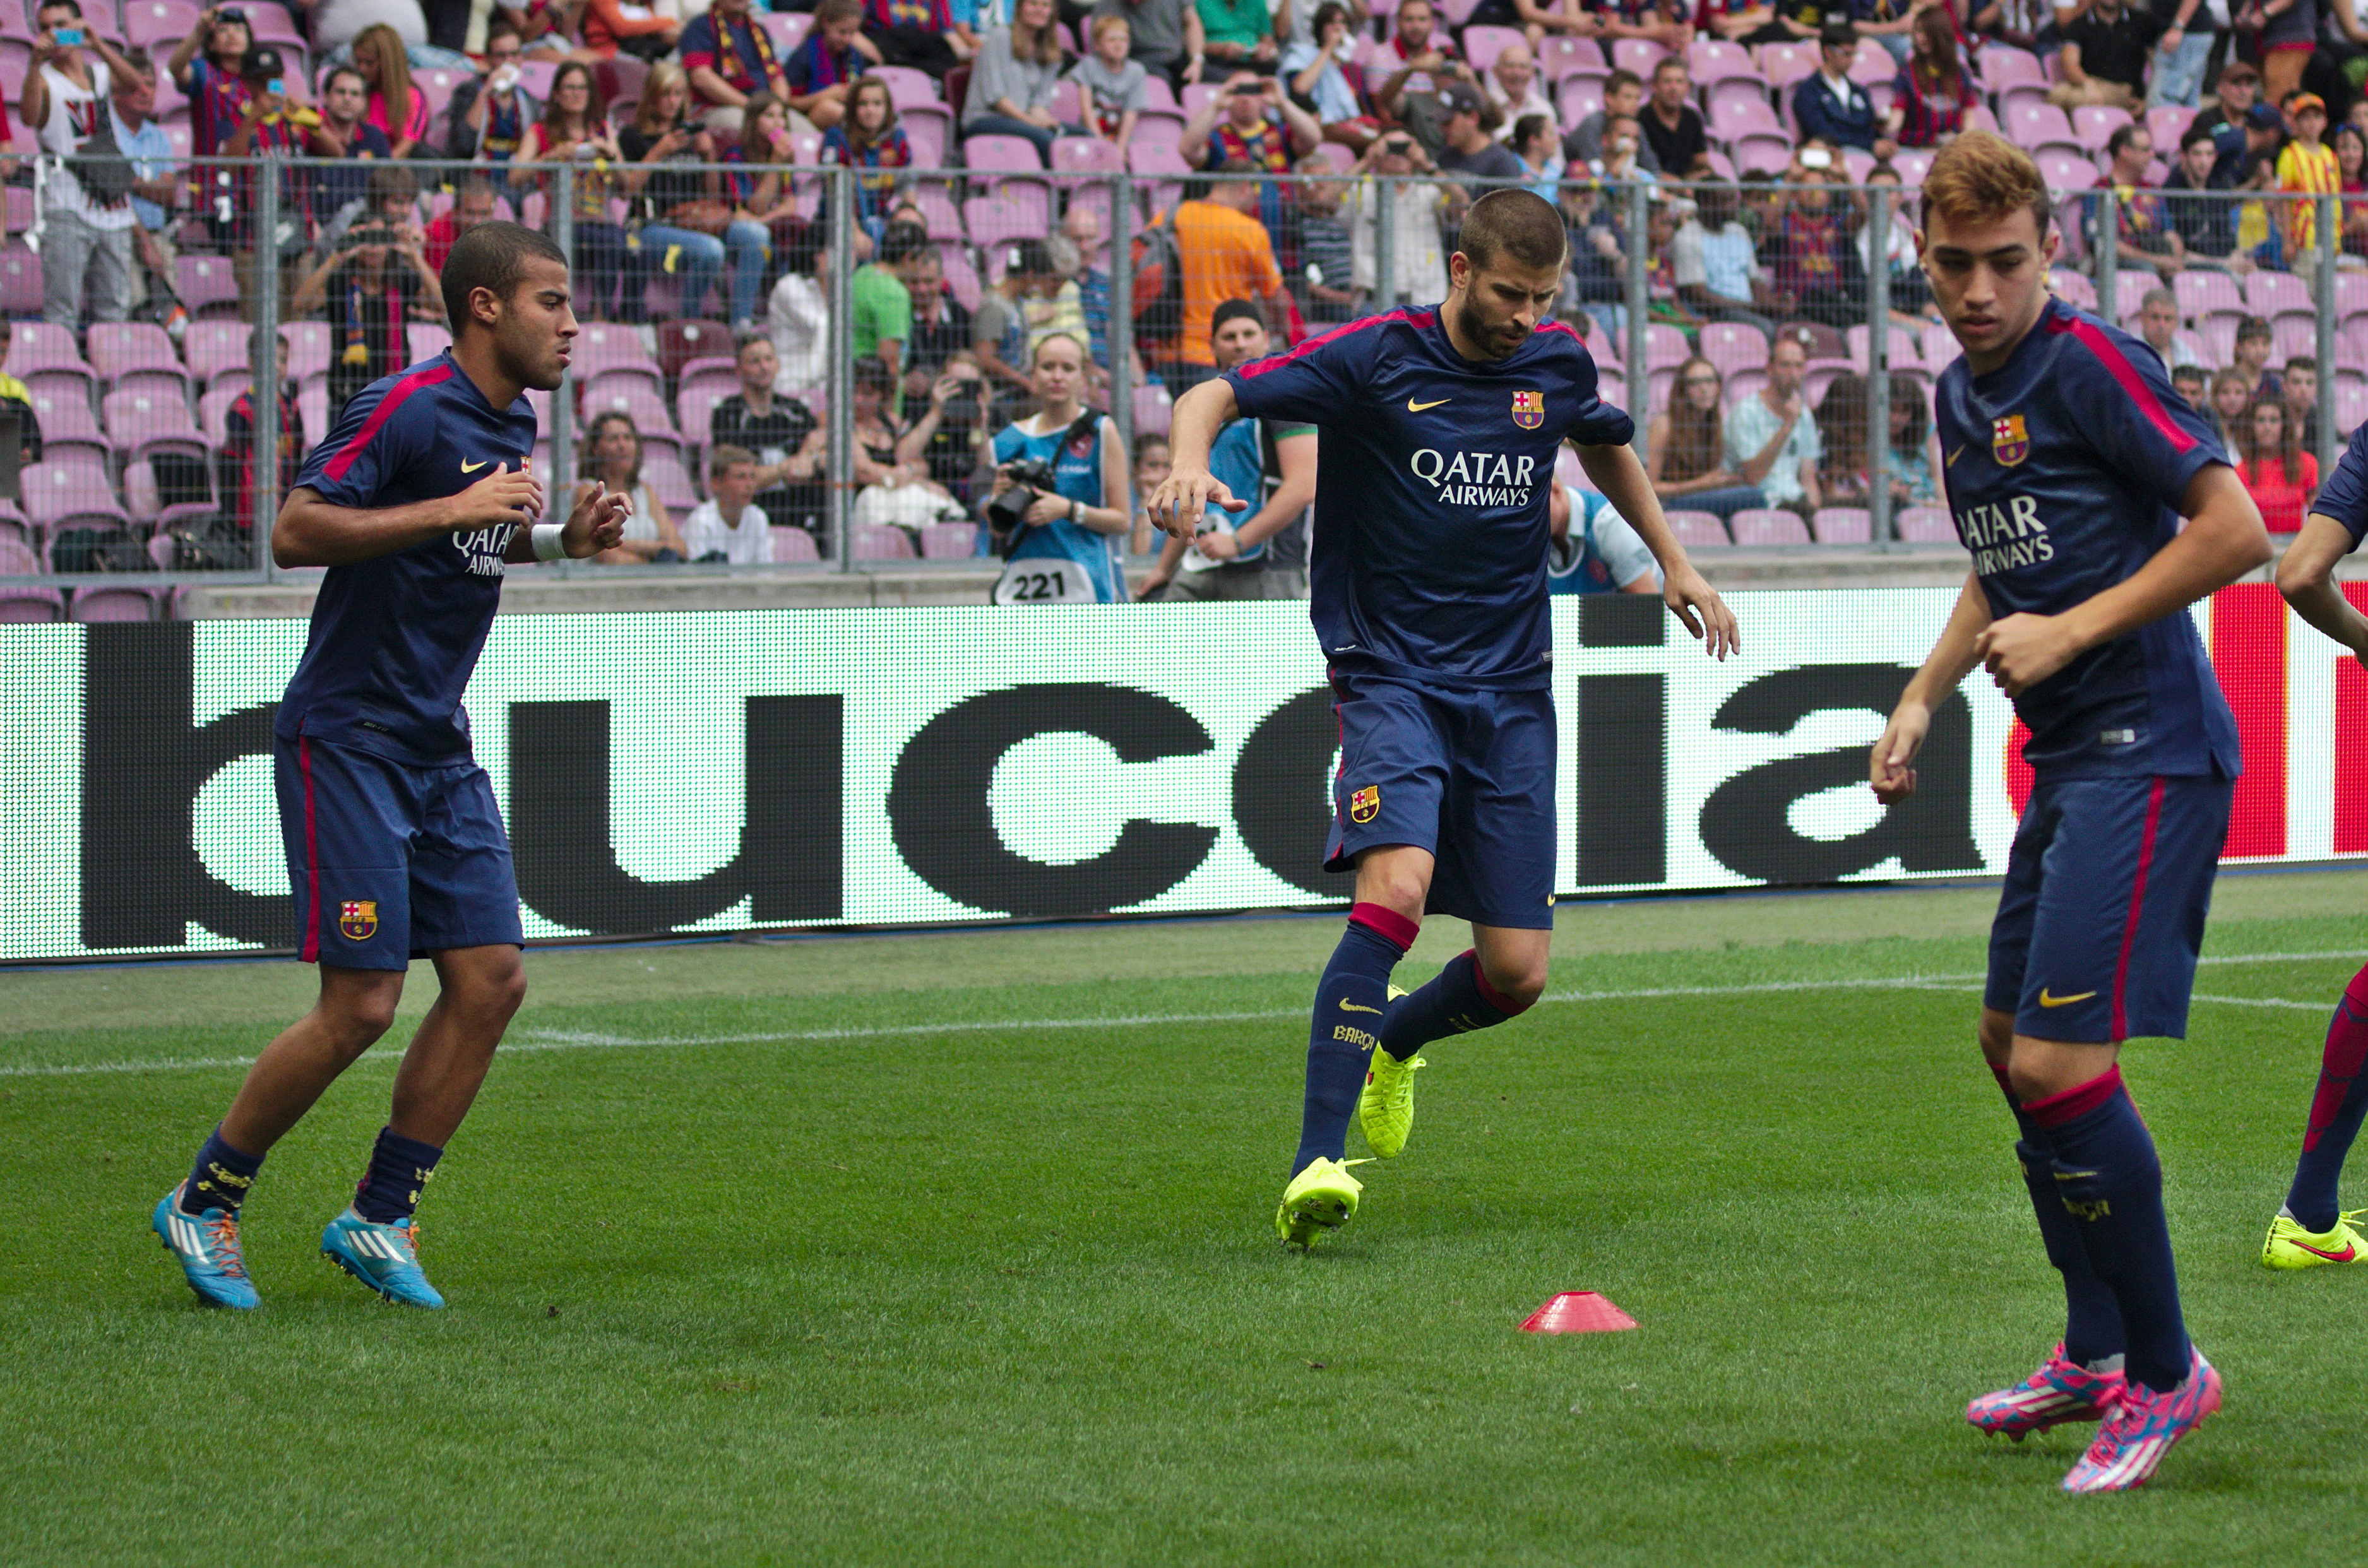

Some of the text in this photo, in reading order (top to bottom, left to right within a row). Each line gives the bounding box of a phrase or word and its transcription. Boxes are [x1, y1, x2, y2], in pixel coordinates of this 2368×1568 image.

[1410, 449, 1535, 488] QATAR
[1438, 484, 1530, 506] AIRWAYS
[1957, 495, 2048, 550] ATAR
[1972, 534, 2054, 576] IRWAYS
[1013, 571, 1064, 600] 221
[1333, 1025, 1375, 1051] BARÇA
